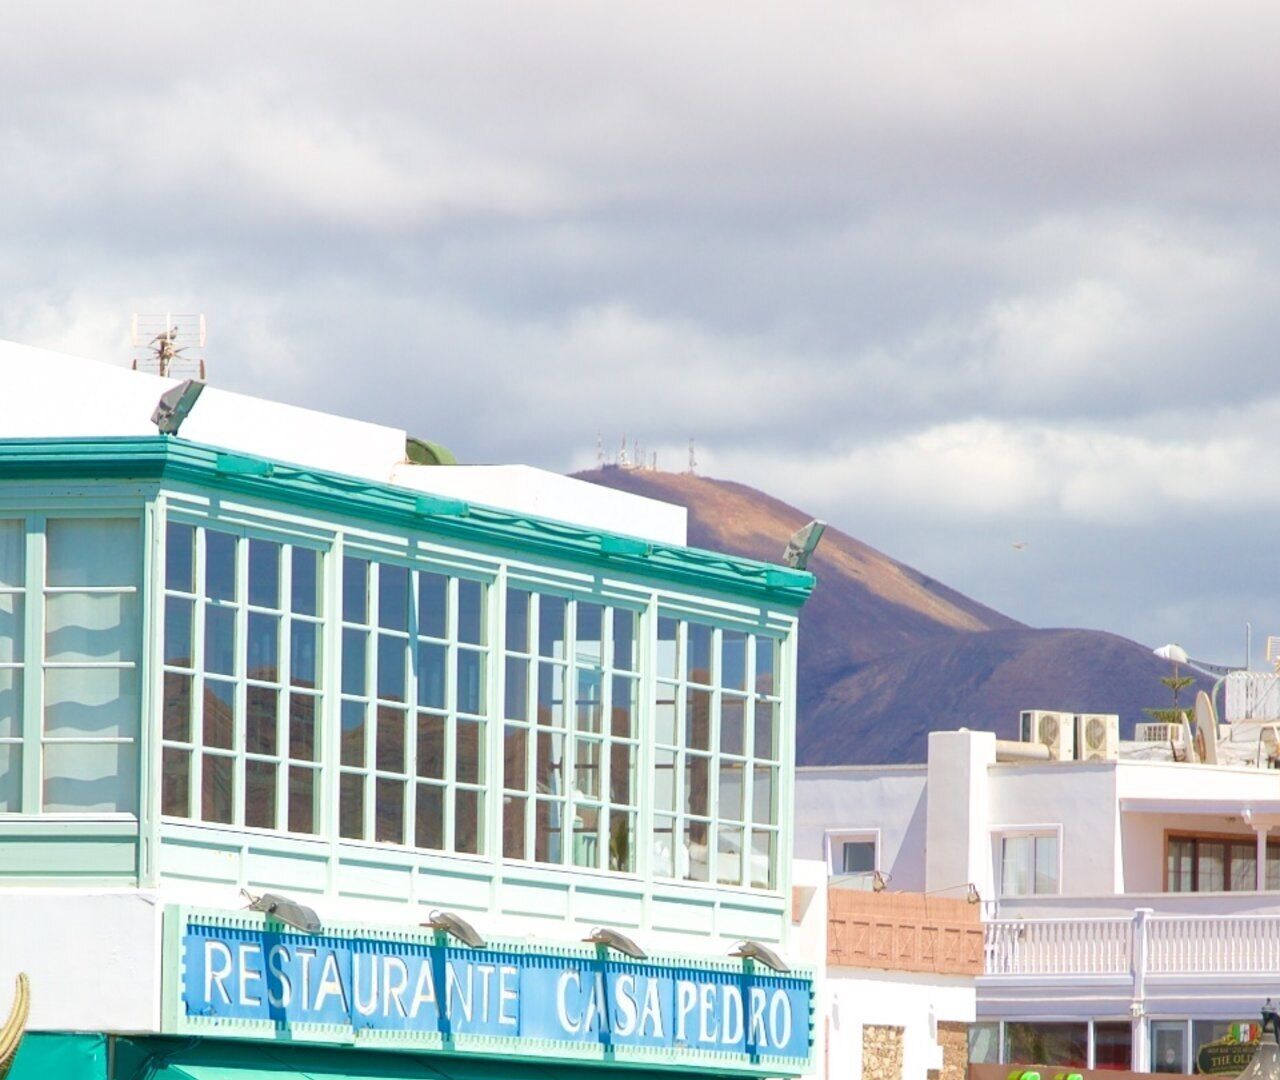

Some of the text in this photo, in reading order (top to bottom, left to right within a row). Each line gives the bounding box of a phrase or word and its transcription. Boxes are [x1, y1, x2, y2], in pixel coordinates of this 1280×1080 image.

[204, 940, 792, 1051] RESTAURANTE CASA PEDRO
